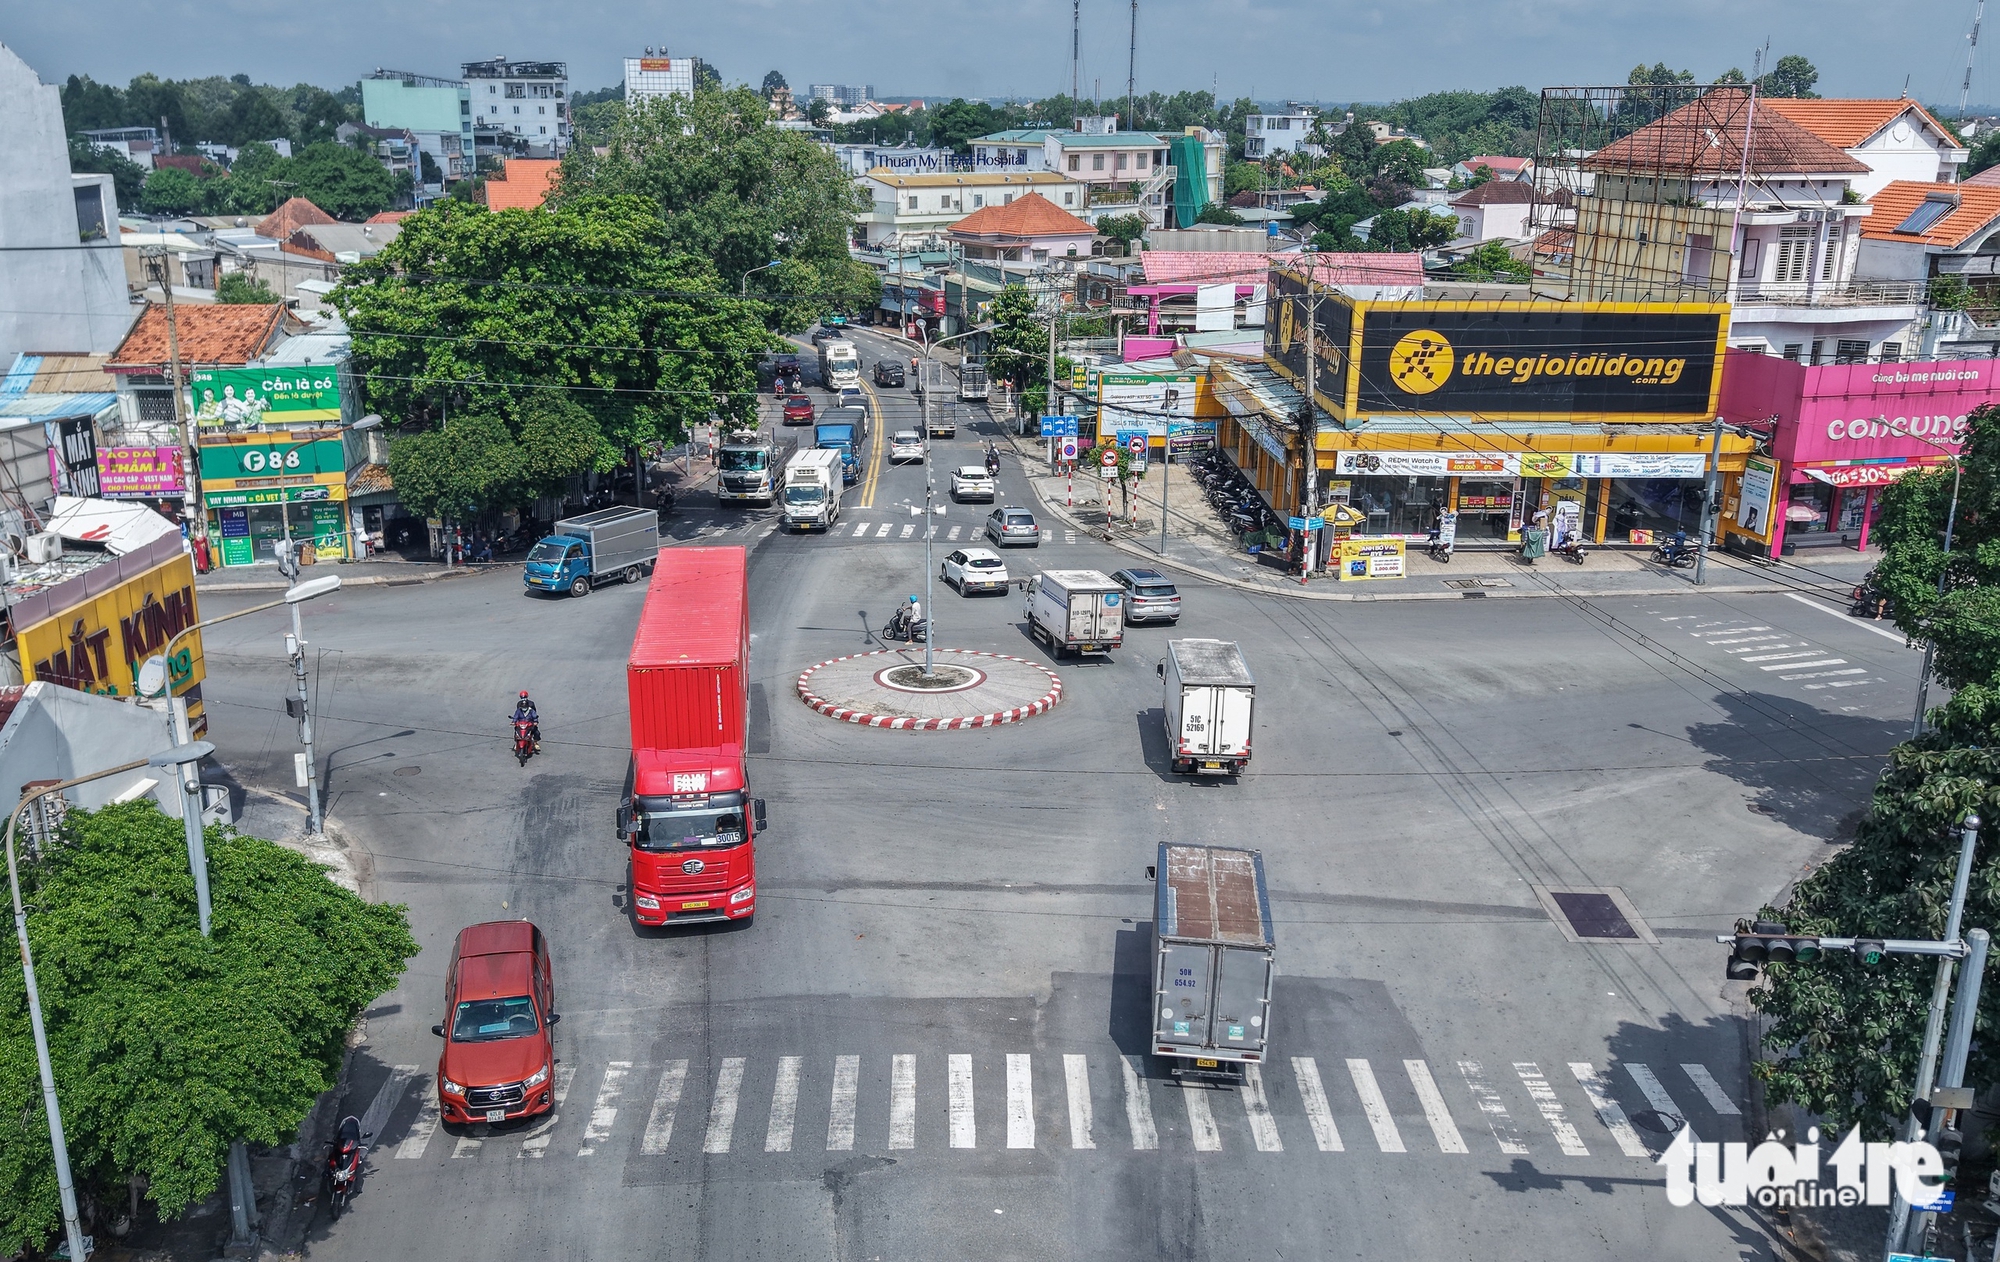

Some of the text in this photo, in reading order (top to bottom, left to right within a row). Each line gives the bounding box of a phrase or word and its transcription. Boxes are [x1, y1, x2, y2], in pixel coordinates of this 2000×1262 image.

[877, 155, 916, 168] Thuan
[919, 155, 939, 169] My
[977, 152, 1028, 169] Hospital
[1462, 352, 1687, 385] thegioididong
[1631, 376, 1659, 385] .com
[1872, 369, 1979, 385] Cùng ba mẹ nuôi con
[262, 376, 332, 391] Cần là có
[274, 392, 290, 400] Đến
[304, 391, 323, 401] duyệt
[65, 421, 92, 464] MẮT
[1411, 456, 1433, 464] Watch
[70, 464, 99, 498] KÍNH
[159, 474, 173, 482] NAM
[209, 497, 222, 505] VAY
[223, 495, 247, 504] NHANH
[255, 492, 265, 502] CÀ
[266, 494, 279, 503] VẸT
[34, 584, 196, 690] MẮT KÍNH
[1190, 714, 1201, 723] 51C
[1186, 723, 1204, 732] 52169
[717, 832, 740, 843] 30015
[1179, 968, 1192, 976] 50H
[1174, 979, 1196, 987] 654.92
